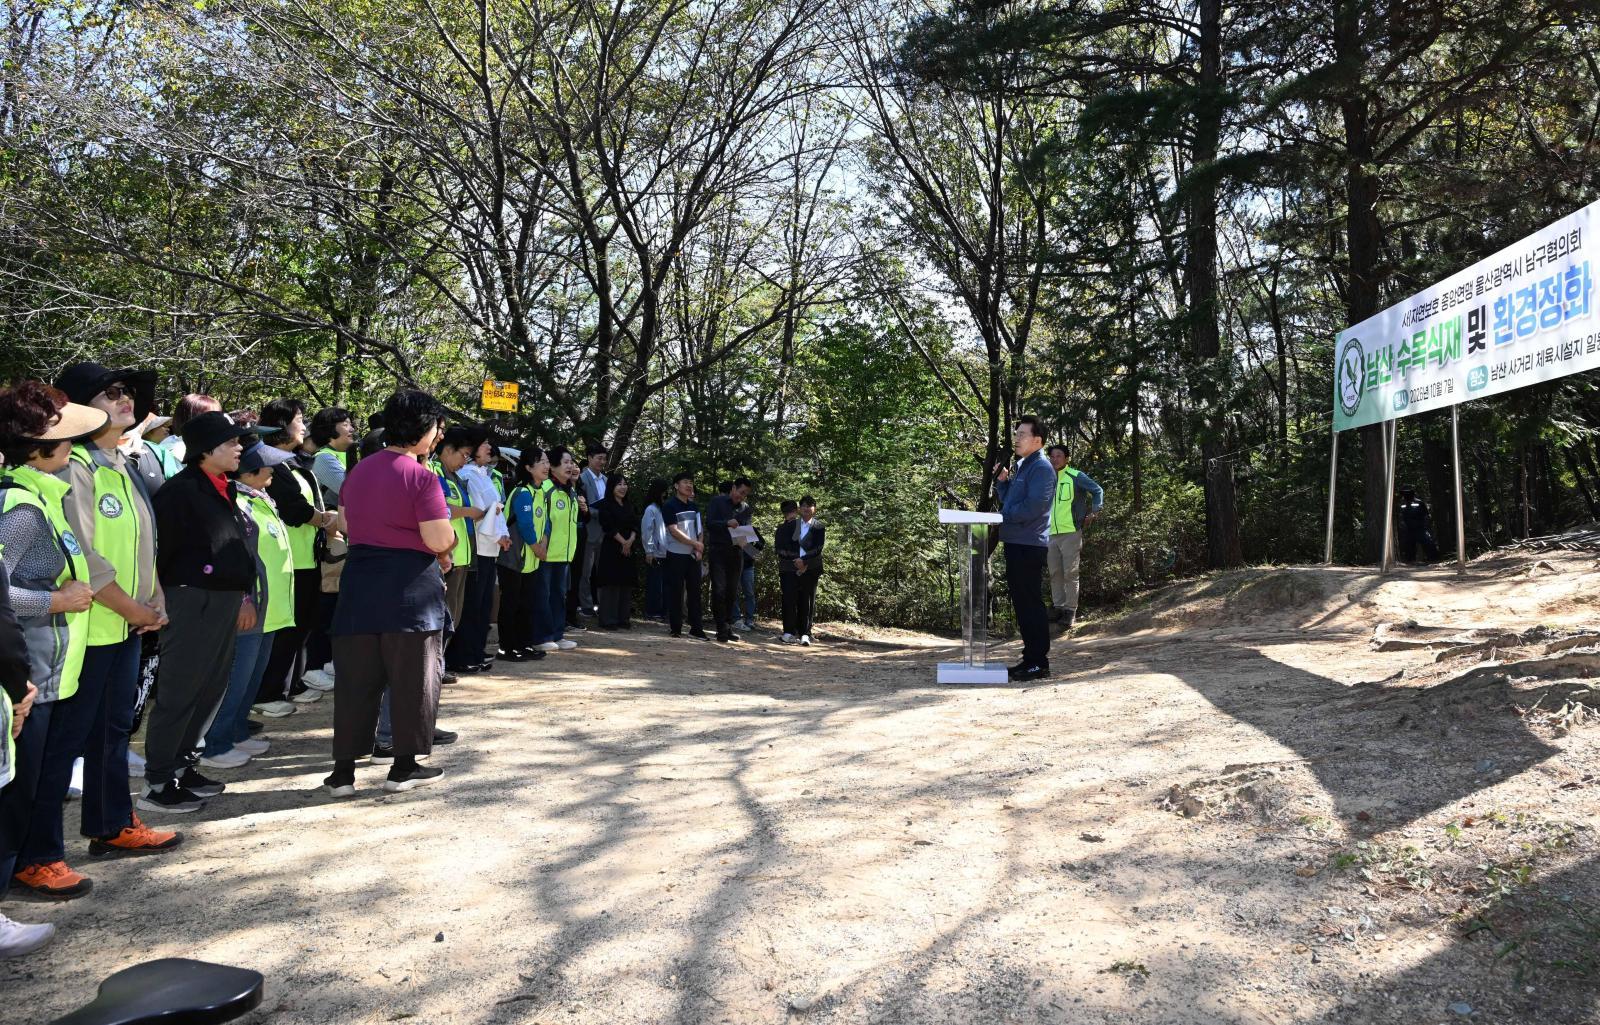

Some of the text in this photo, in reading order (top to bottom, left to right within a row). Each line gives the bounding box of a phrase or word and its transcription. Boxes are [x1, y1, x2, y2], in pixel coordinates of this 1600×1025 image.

[1441, 280, 1474, 312] 중앙연맹
[1475, 256, 1522, 296] 울산광역시
[1525, 226, 1582, 274] 남구협의회
[1366, 259, 1593, 388] 남산 수목식재 및 환경정화
[1430, 380, 1443, 398] 10월
[1443, 377, 1454, 394] 7일
[1490, 361, 1507, 382] 남산
[1508, 352, 1534, 376] 사거리
[1535, 337, 1584, 368] 체육시설지
